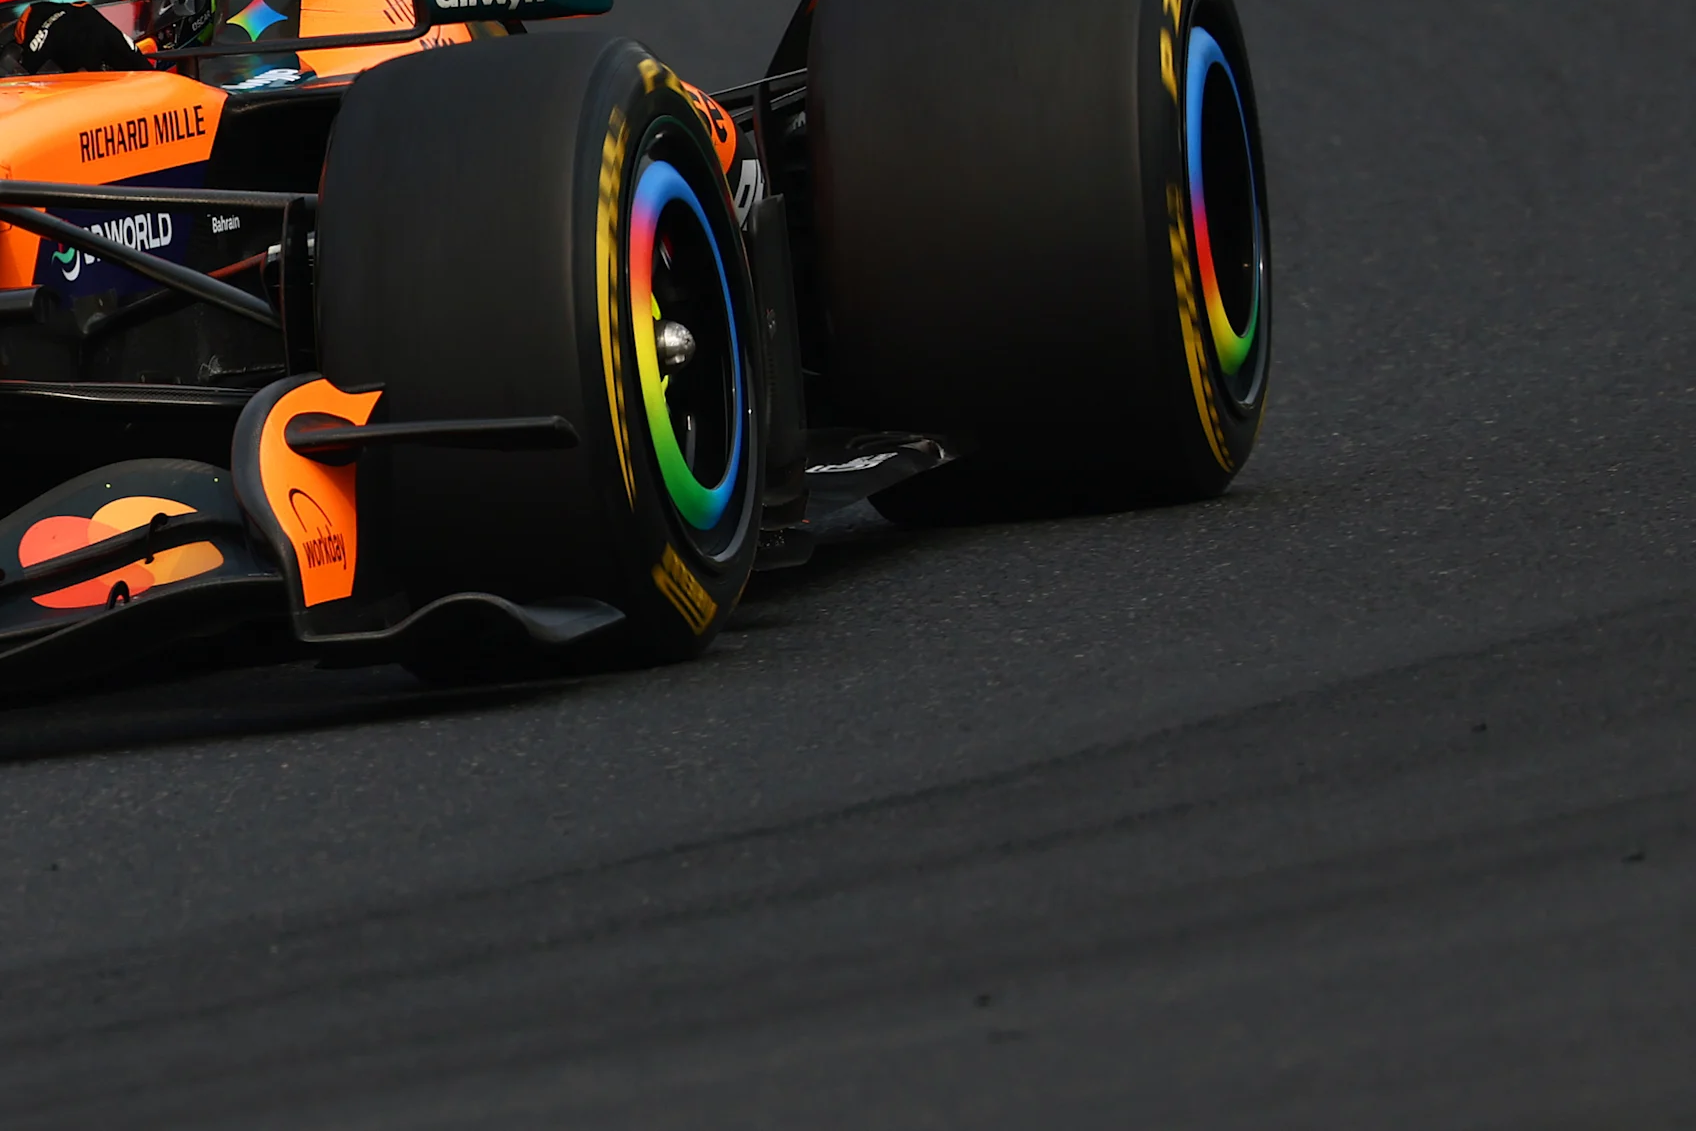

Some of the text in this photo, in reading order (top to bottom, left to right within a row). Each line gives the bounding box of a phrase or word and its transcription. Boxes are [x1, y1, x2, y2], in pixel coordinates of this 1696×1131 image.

[79, 105, 206, 164] RICHARD MILLE
[104, 212, 173, 252] WORLD
[212, 215, 240, 234] Bahrain
[302, 524, 347, 570] workday
